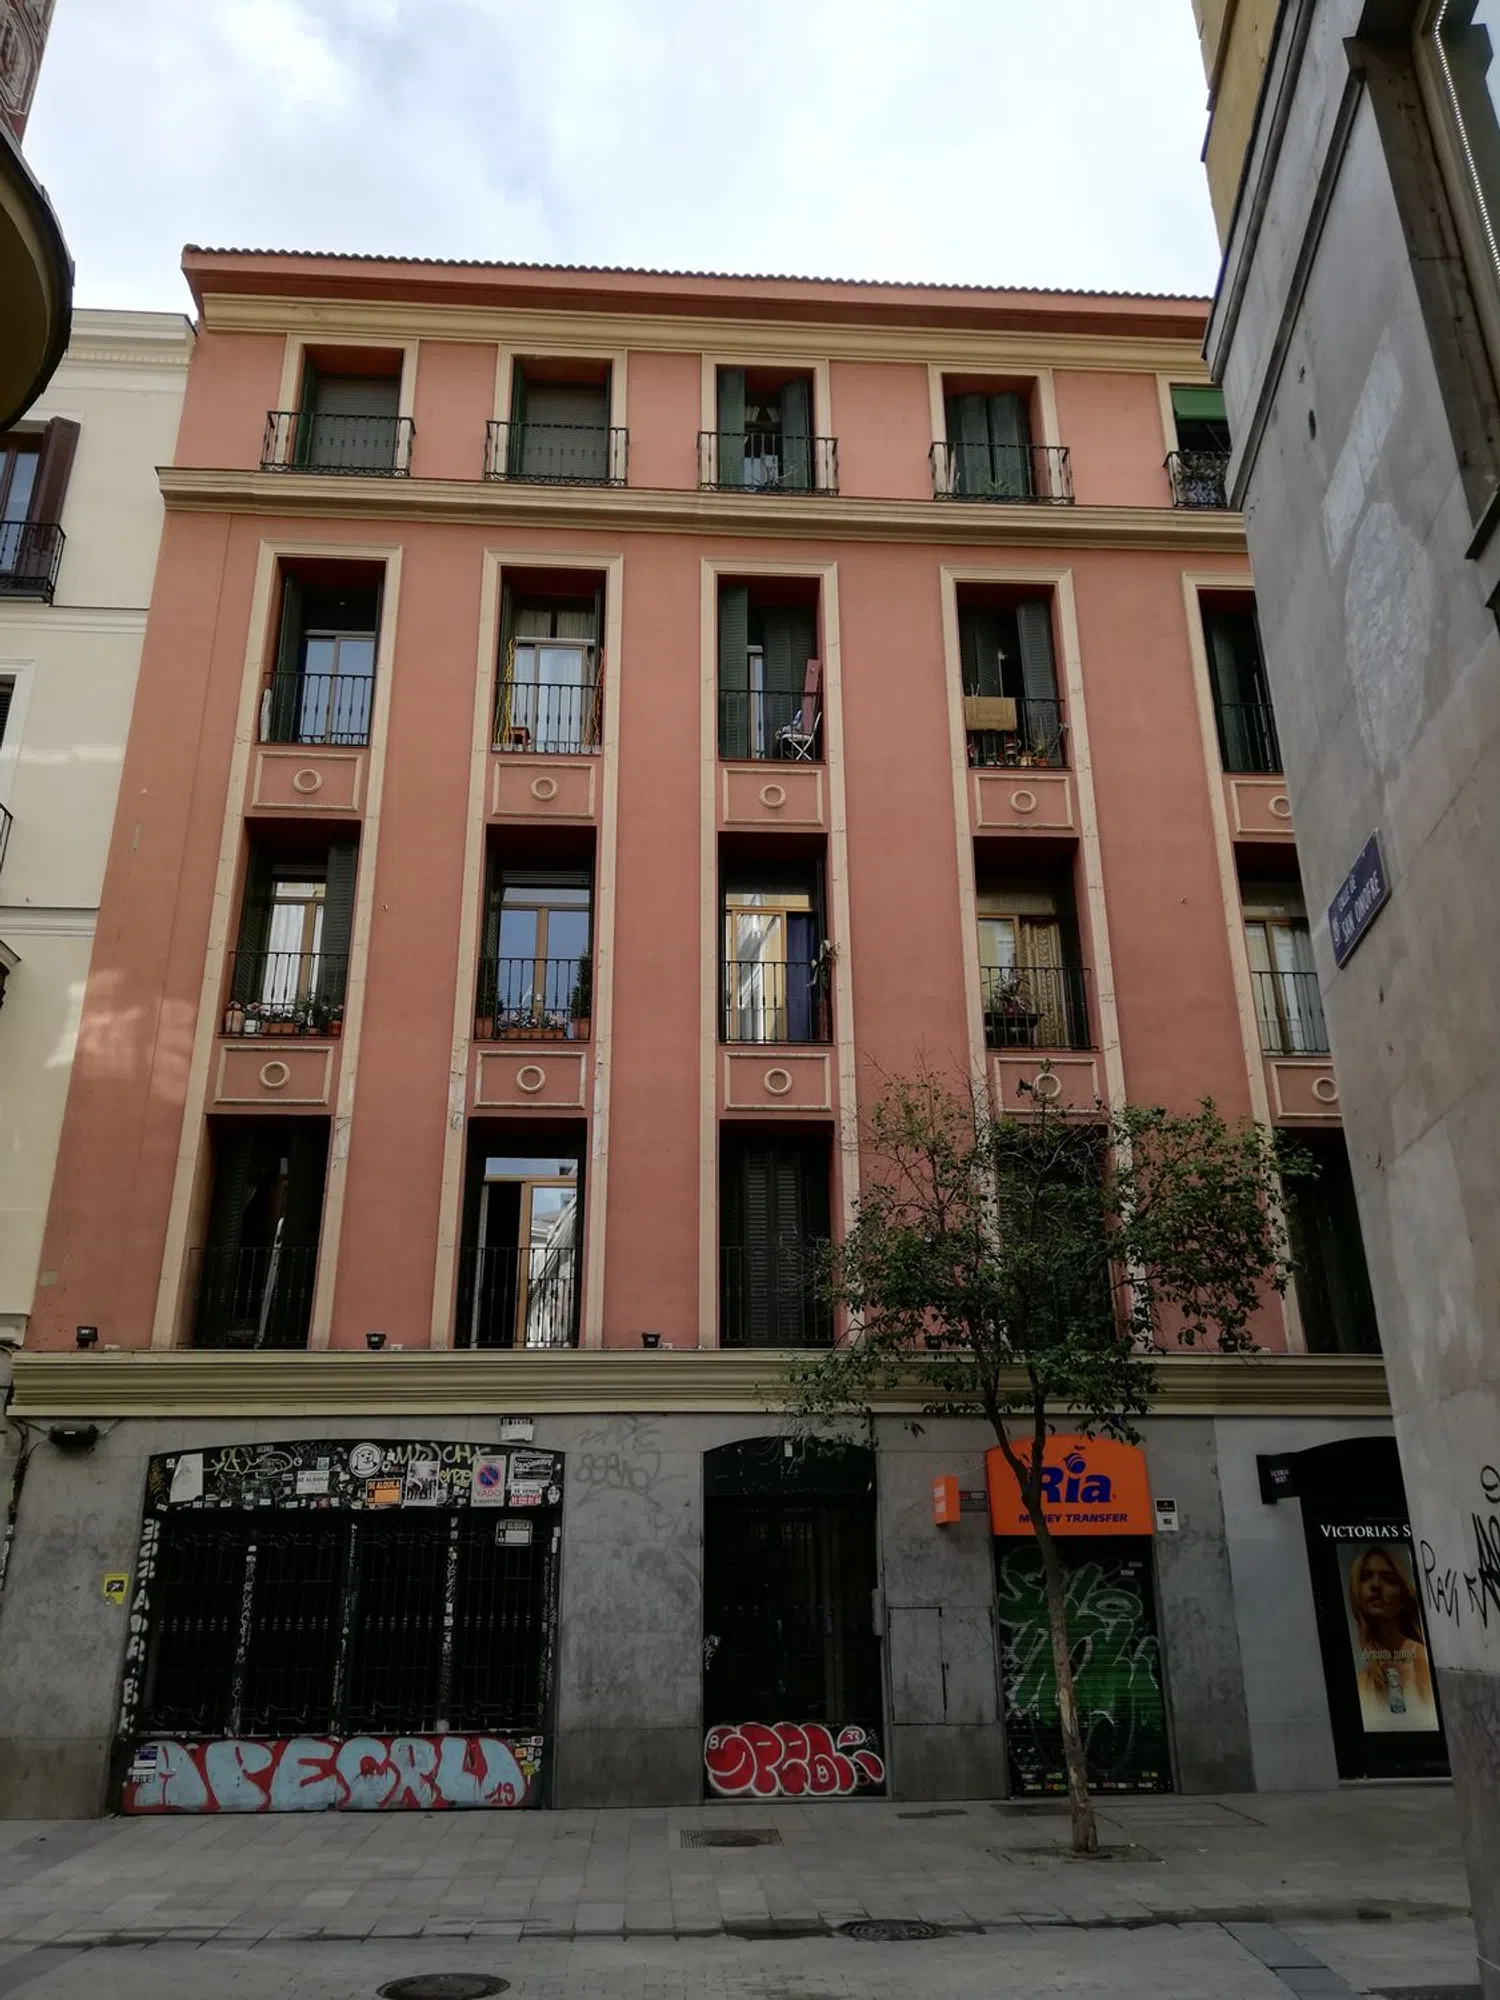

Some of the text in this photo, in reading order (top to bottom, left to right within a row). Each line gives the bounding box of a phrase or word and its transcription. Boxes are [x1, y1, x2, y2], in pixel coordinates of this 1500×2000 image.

[1337, 886, 1351, 912] CALLE
[1341, 870, 1381, 943] SAN ONOFRE
[368, 1480, 400, 1490] SE ALQUILA
[476, 1490, 502, 1498] VADO
[1066, 1514, 1128, 1523] TRANSFER
[1320, 1524, 1398, 1538] VICTORIA'S
